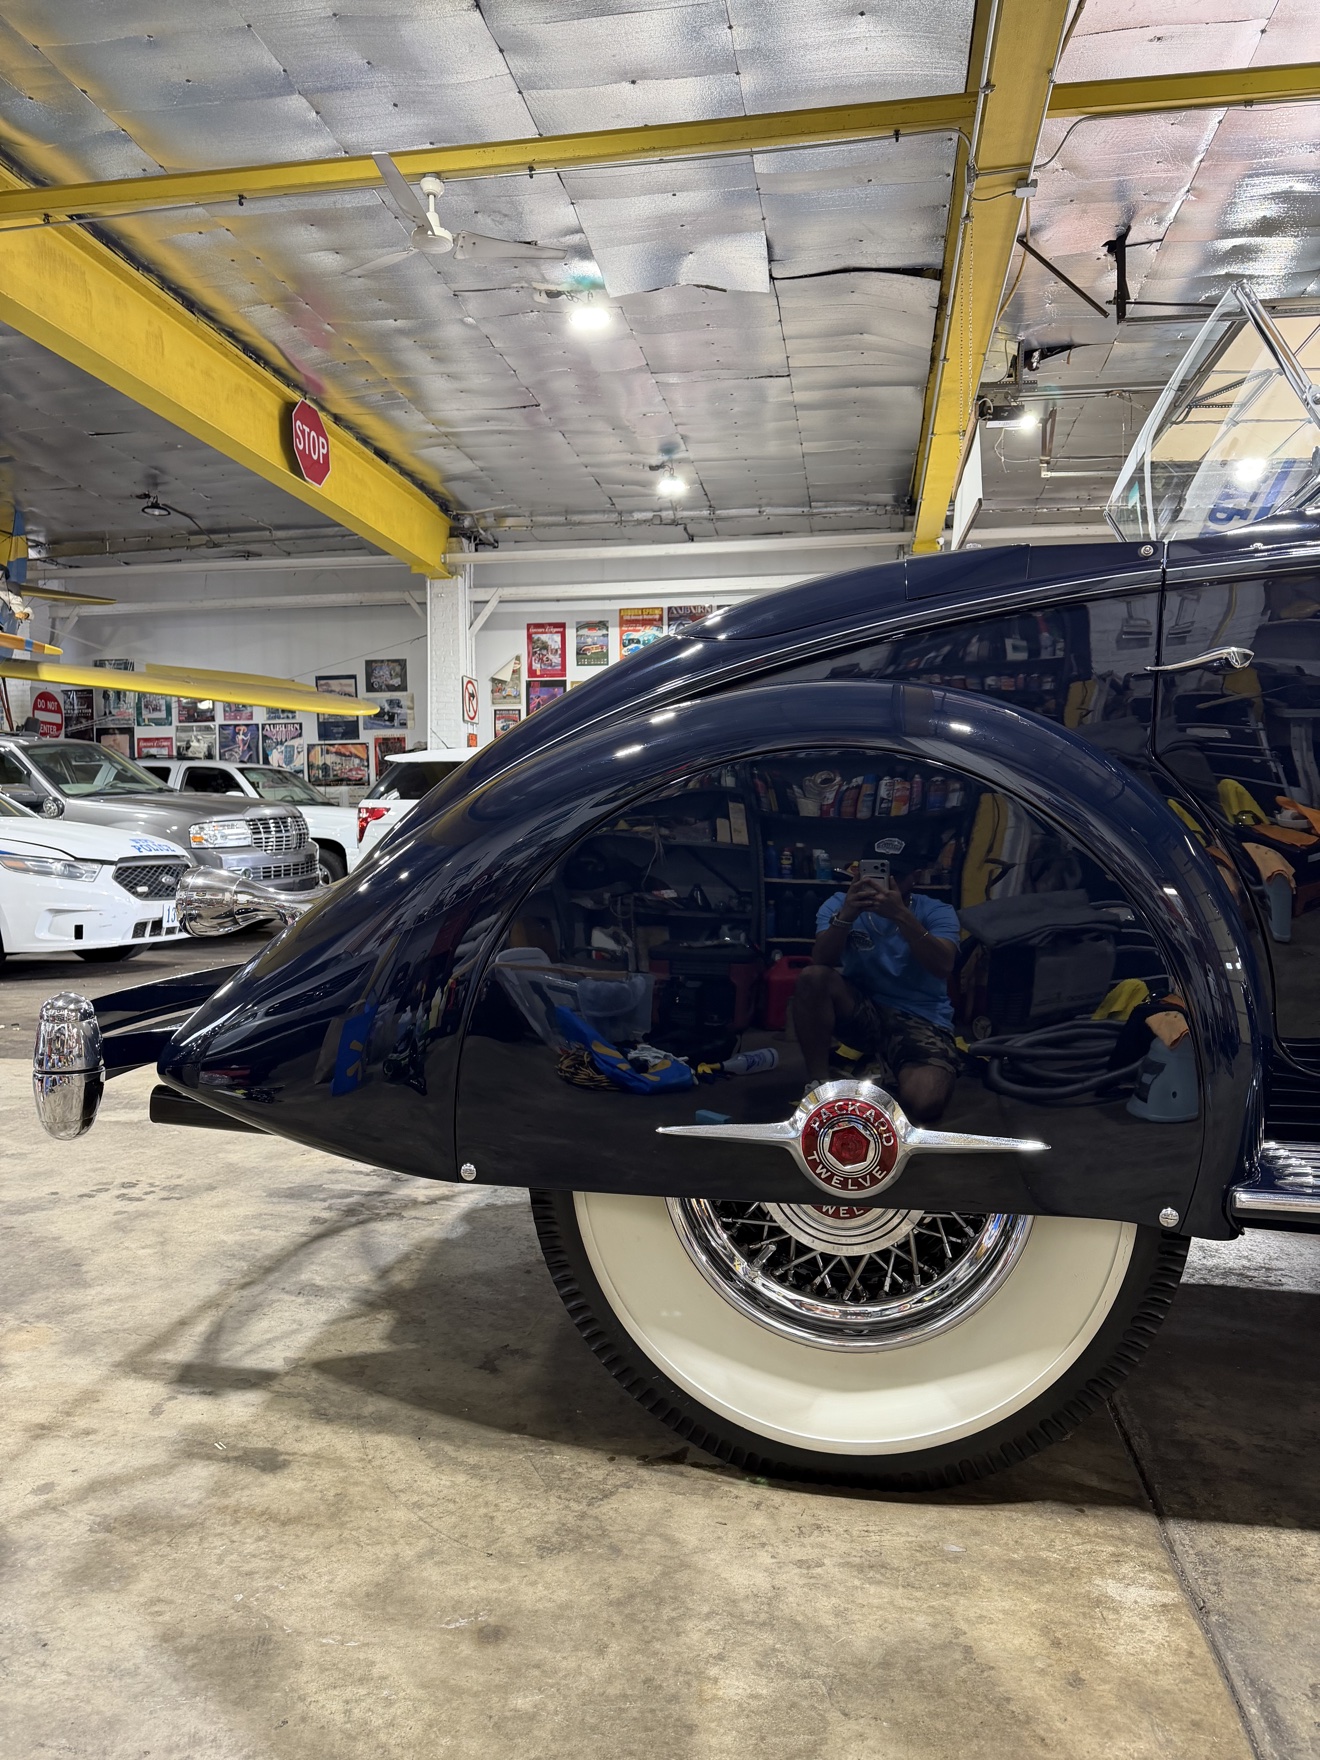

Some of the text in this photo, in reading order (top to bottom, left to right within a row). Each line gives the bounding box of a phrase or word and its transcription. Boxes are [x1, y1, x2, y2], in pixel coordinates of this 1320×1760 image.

[296, 420, 328, 464] STOP
[670, 604, 712, 614] AUBURN
[37, 699, 46, 708] DO
[47, 701, 58, 710] NOT
[40, 723, 57, 734] ENTER
[263, 723, 300, 732] AUBURN
[272, 730, 291, 742] 2000
[131, 844, 177, 853] POLICE
[811, 1101, 894, 1147] PACKARD
[807, 1150, 887, 1190] TWELVE
[821, 1204, 865, 1217] WEL
